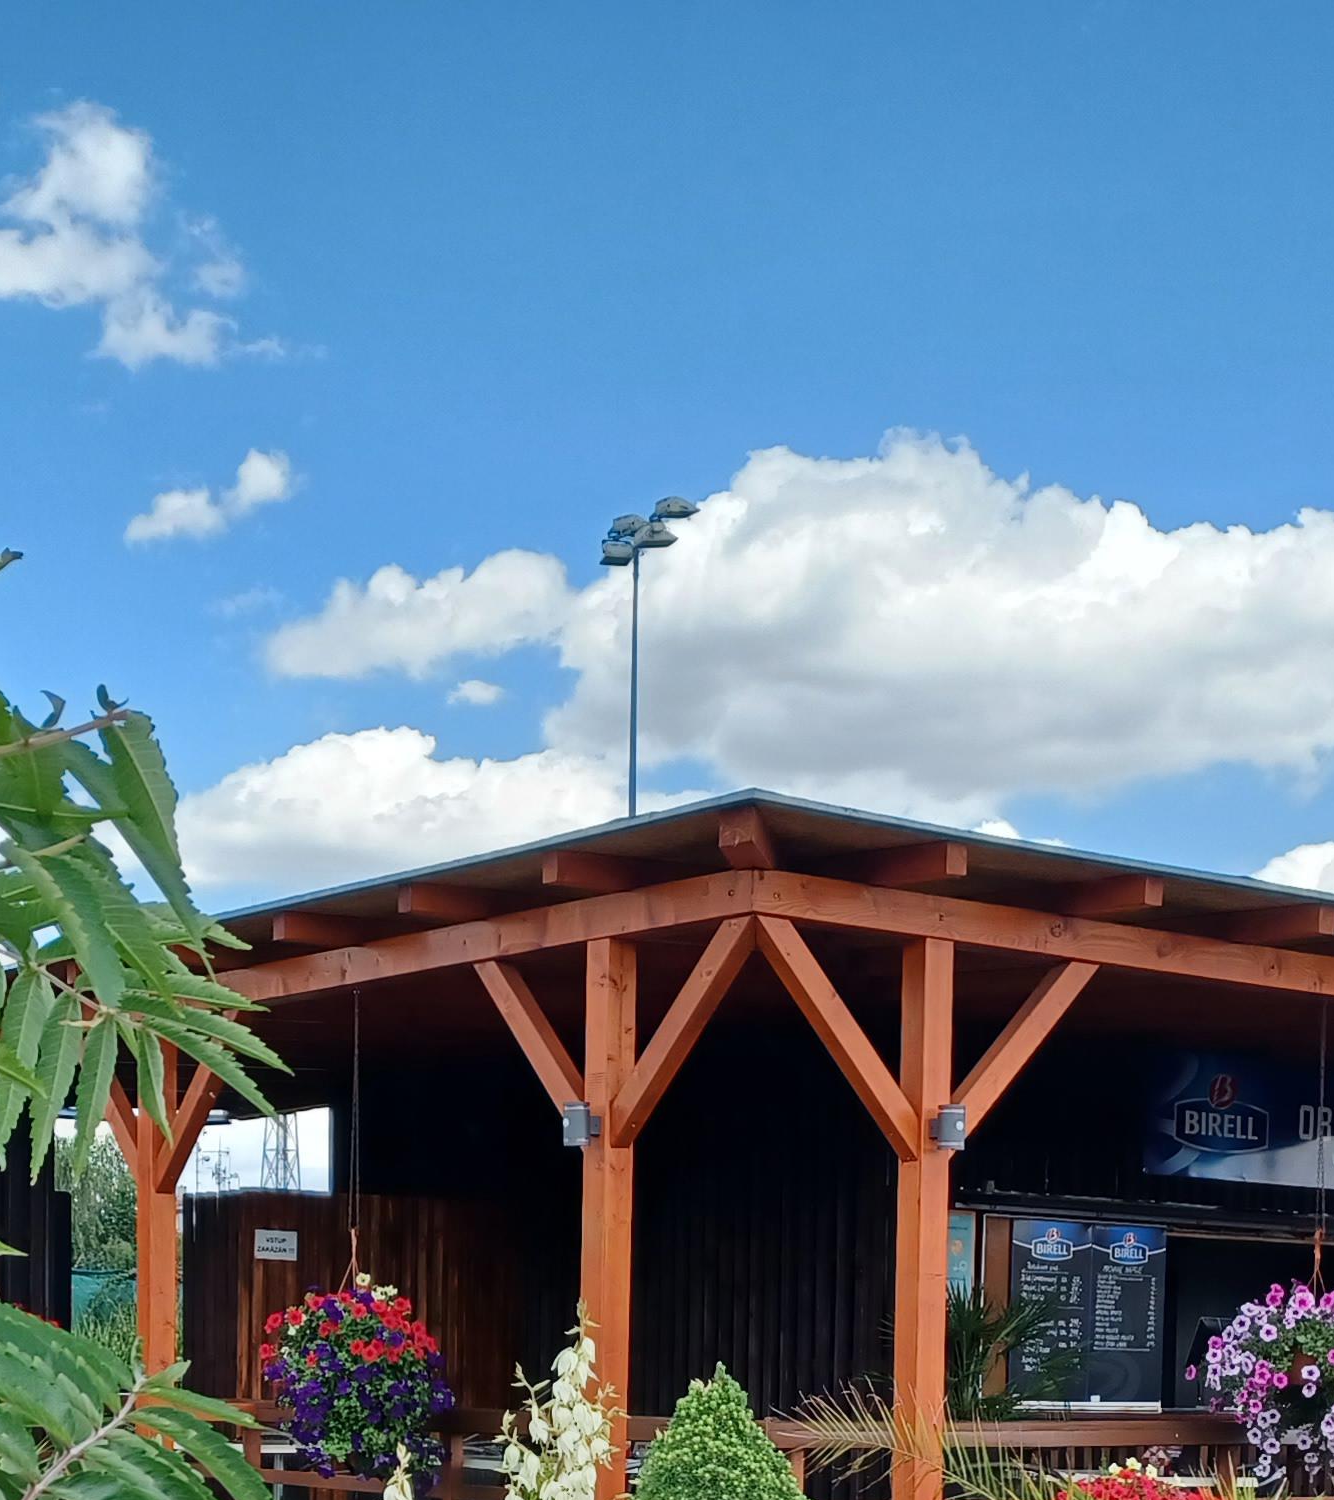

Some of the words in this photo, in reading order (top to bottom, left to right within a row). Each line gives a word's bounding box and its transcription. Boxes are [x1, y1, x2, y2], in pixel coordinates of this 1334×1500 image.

[1184, 1109, 1258, 1141] BIRELL
[1035, 1242, 1069, 1256] BIRELL
[1113, 1246, 1144, 1259] BIRELL
